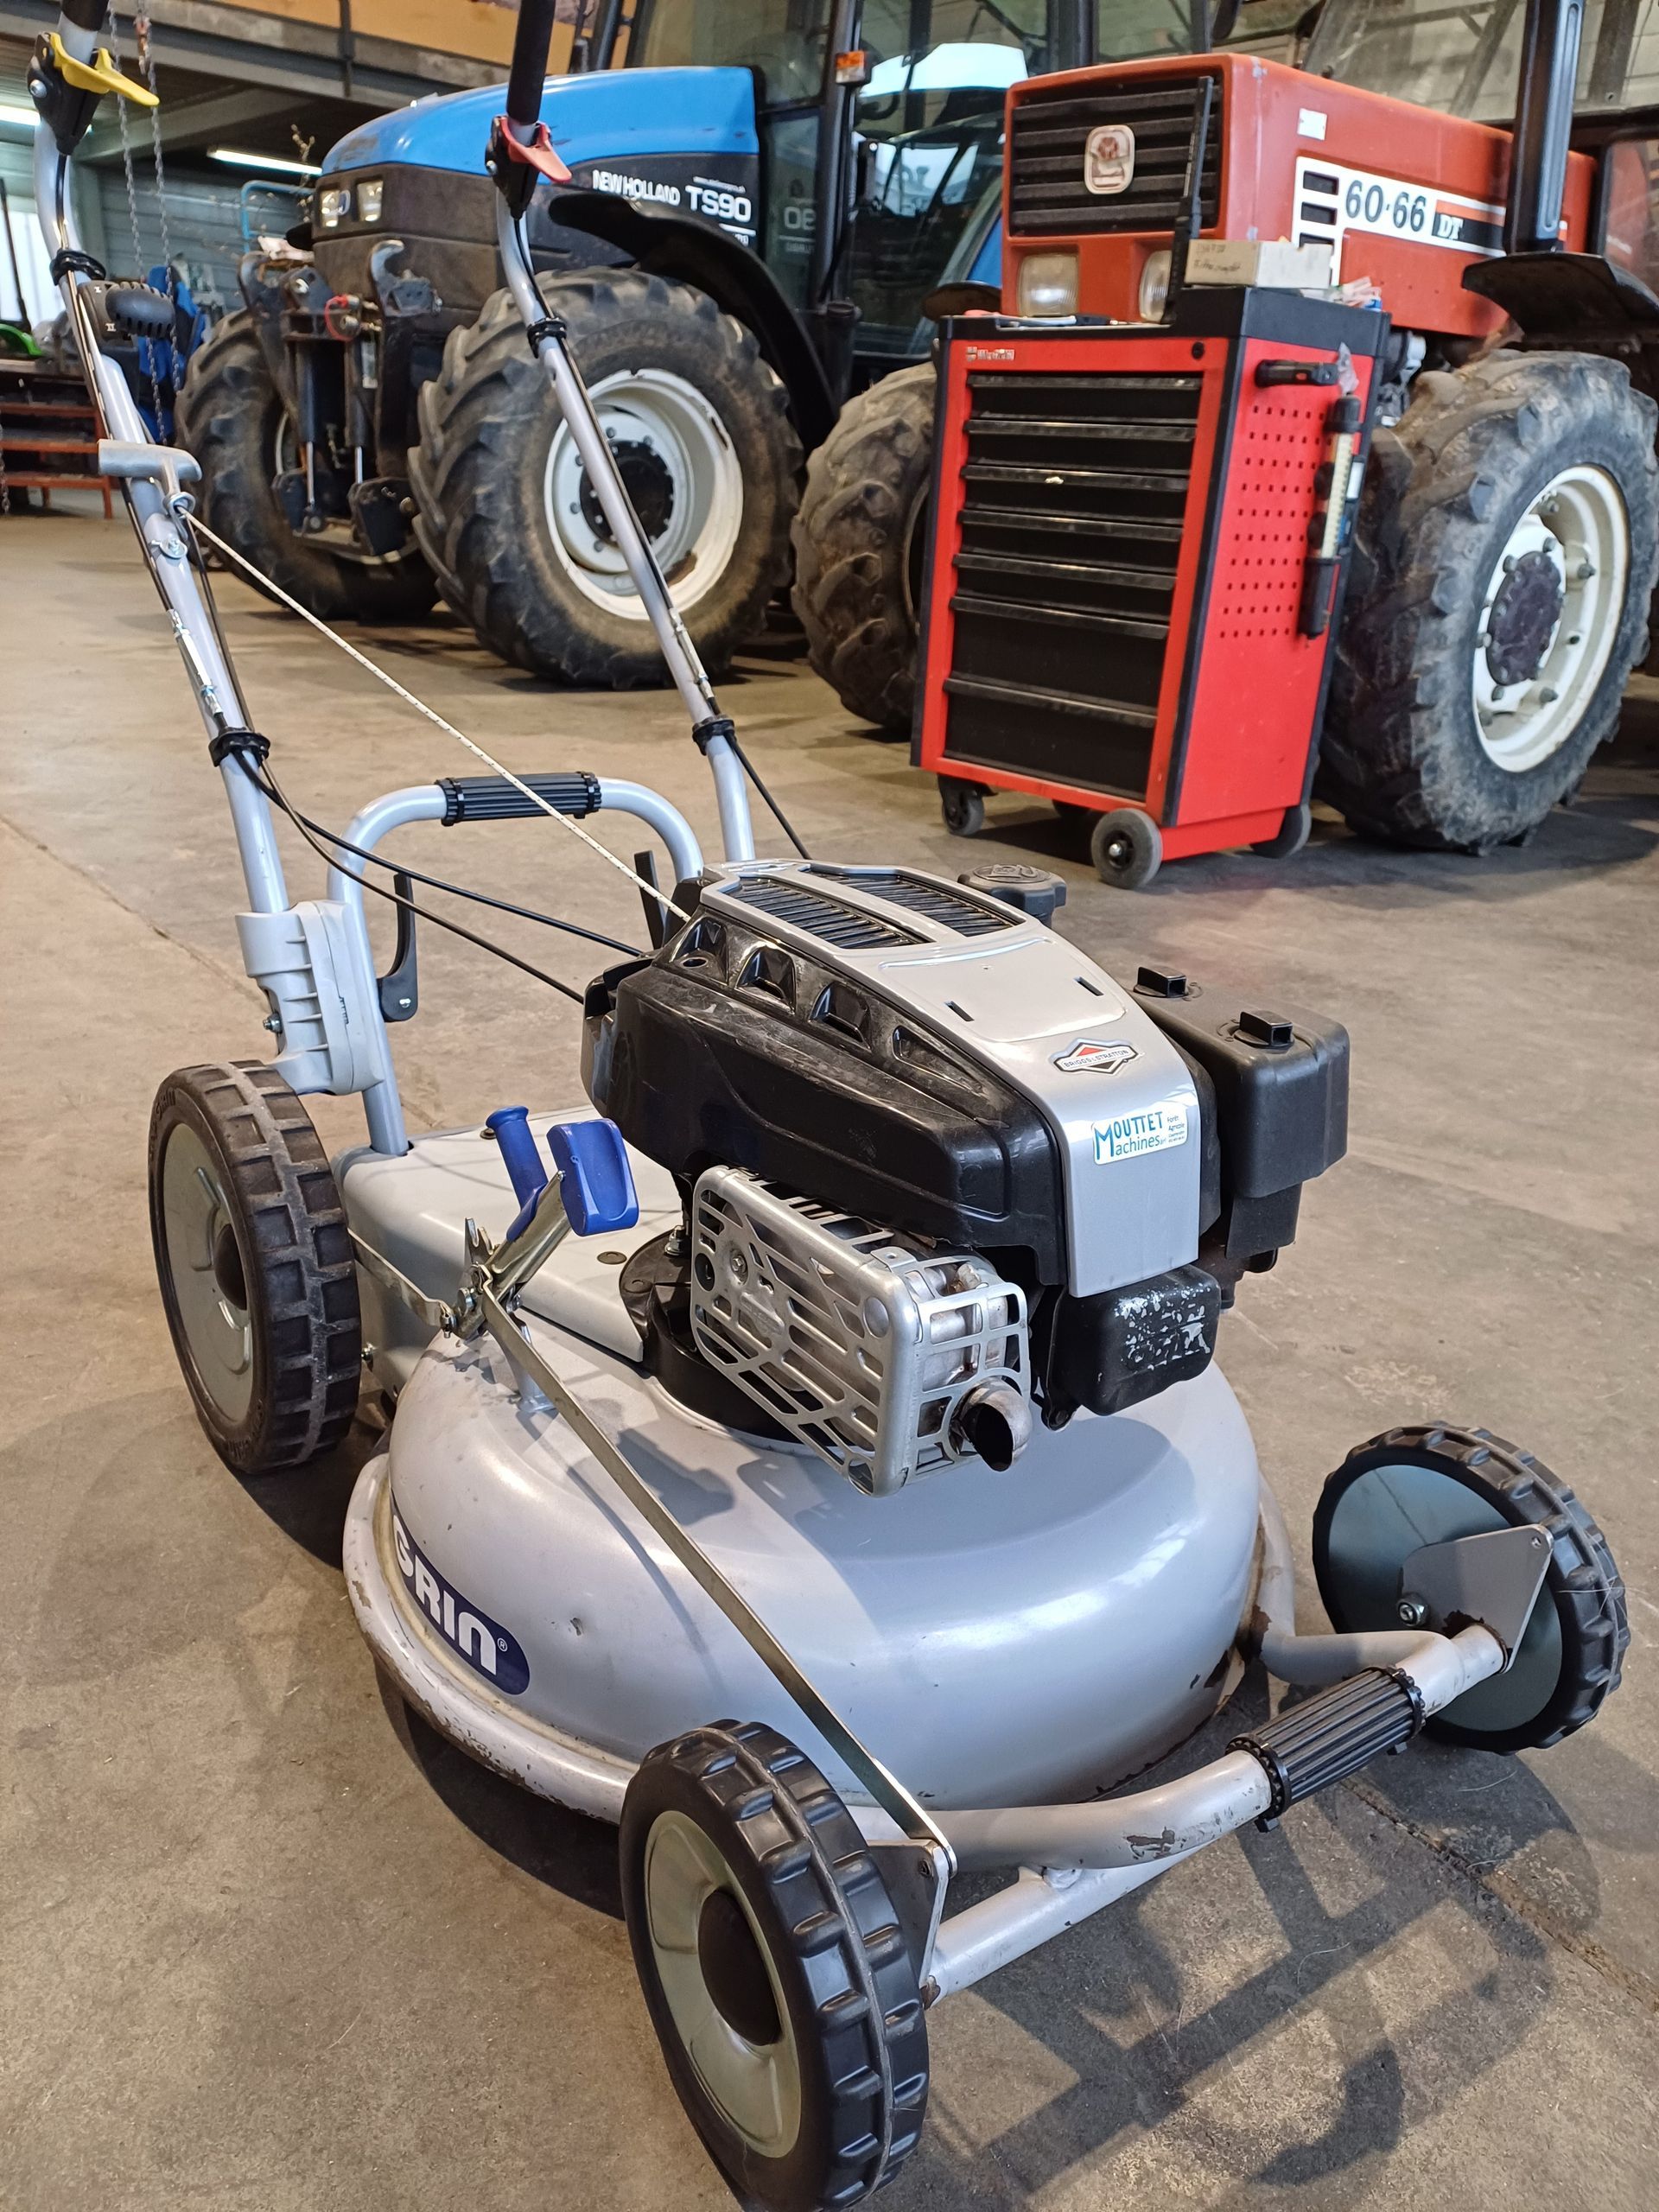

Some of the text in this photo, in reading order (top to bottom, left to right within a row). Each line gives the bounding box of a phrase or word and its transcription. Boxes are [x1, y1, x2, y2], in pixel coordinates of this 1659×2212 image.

[593, 169, 622, 194] NEW
[623, 175, 681, 206] HOLLAND
[685, 185, 752, 222] TS90
[1064, 1057, 1092, 1068] BRIGGS
[1096, 1049, 1129, 1063] STRATTON
